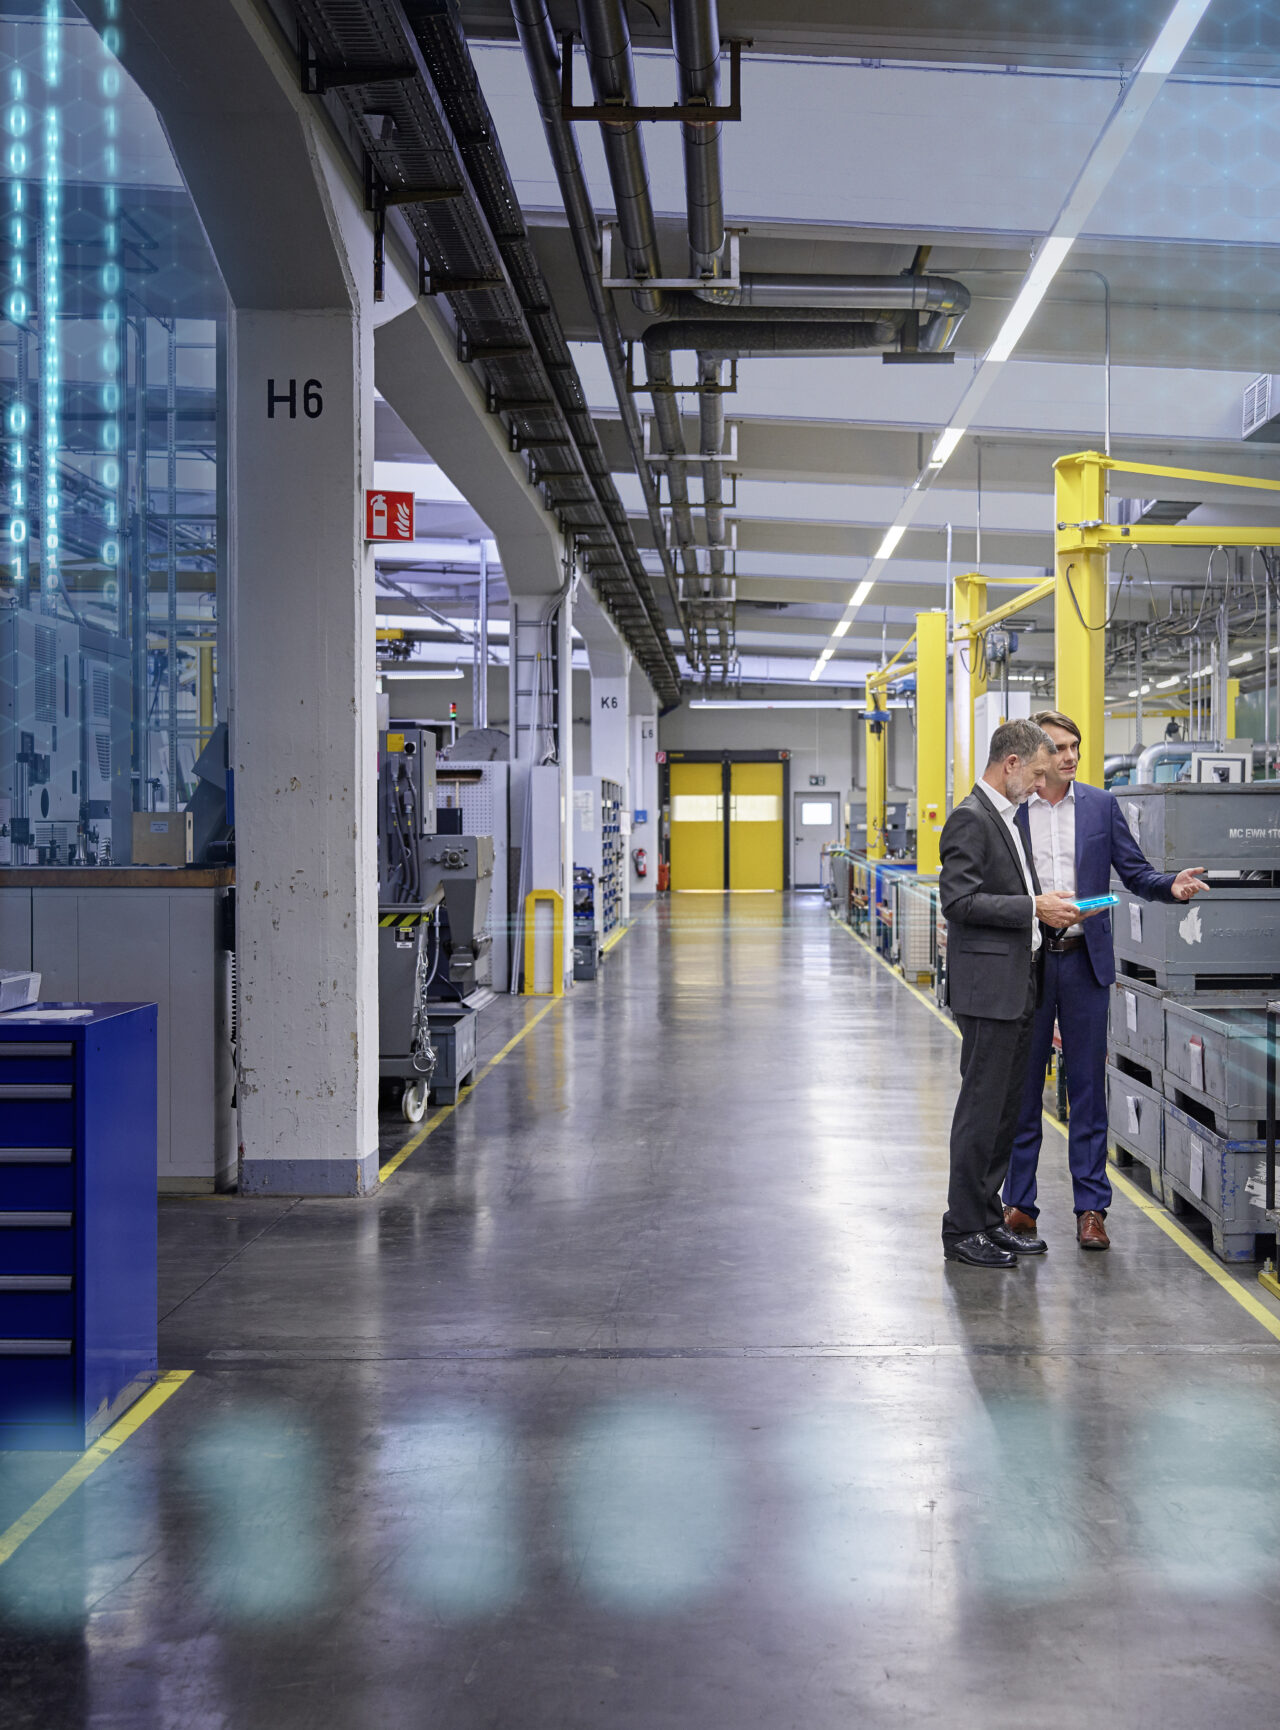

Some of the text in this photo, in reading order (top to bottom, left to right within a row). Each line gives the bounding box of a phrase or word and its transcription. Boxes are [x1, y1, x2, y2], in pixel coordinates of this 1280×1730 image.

[267, 378, 323, 419] H6
[601, 696, 618, 709] K6
[1229, 828, 1244, 839] MC
[1245, 828, 1266, 839] EWN
